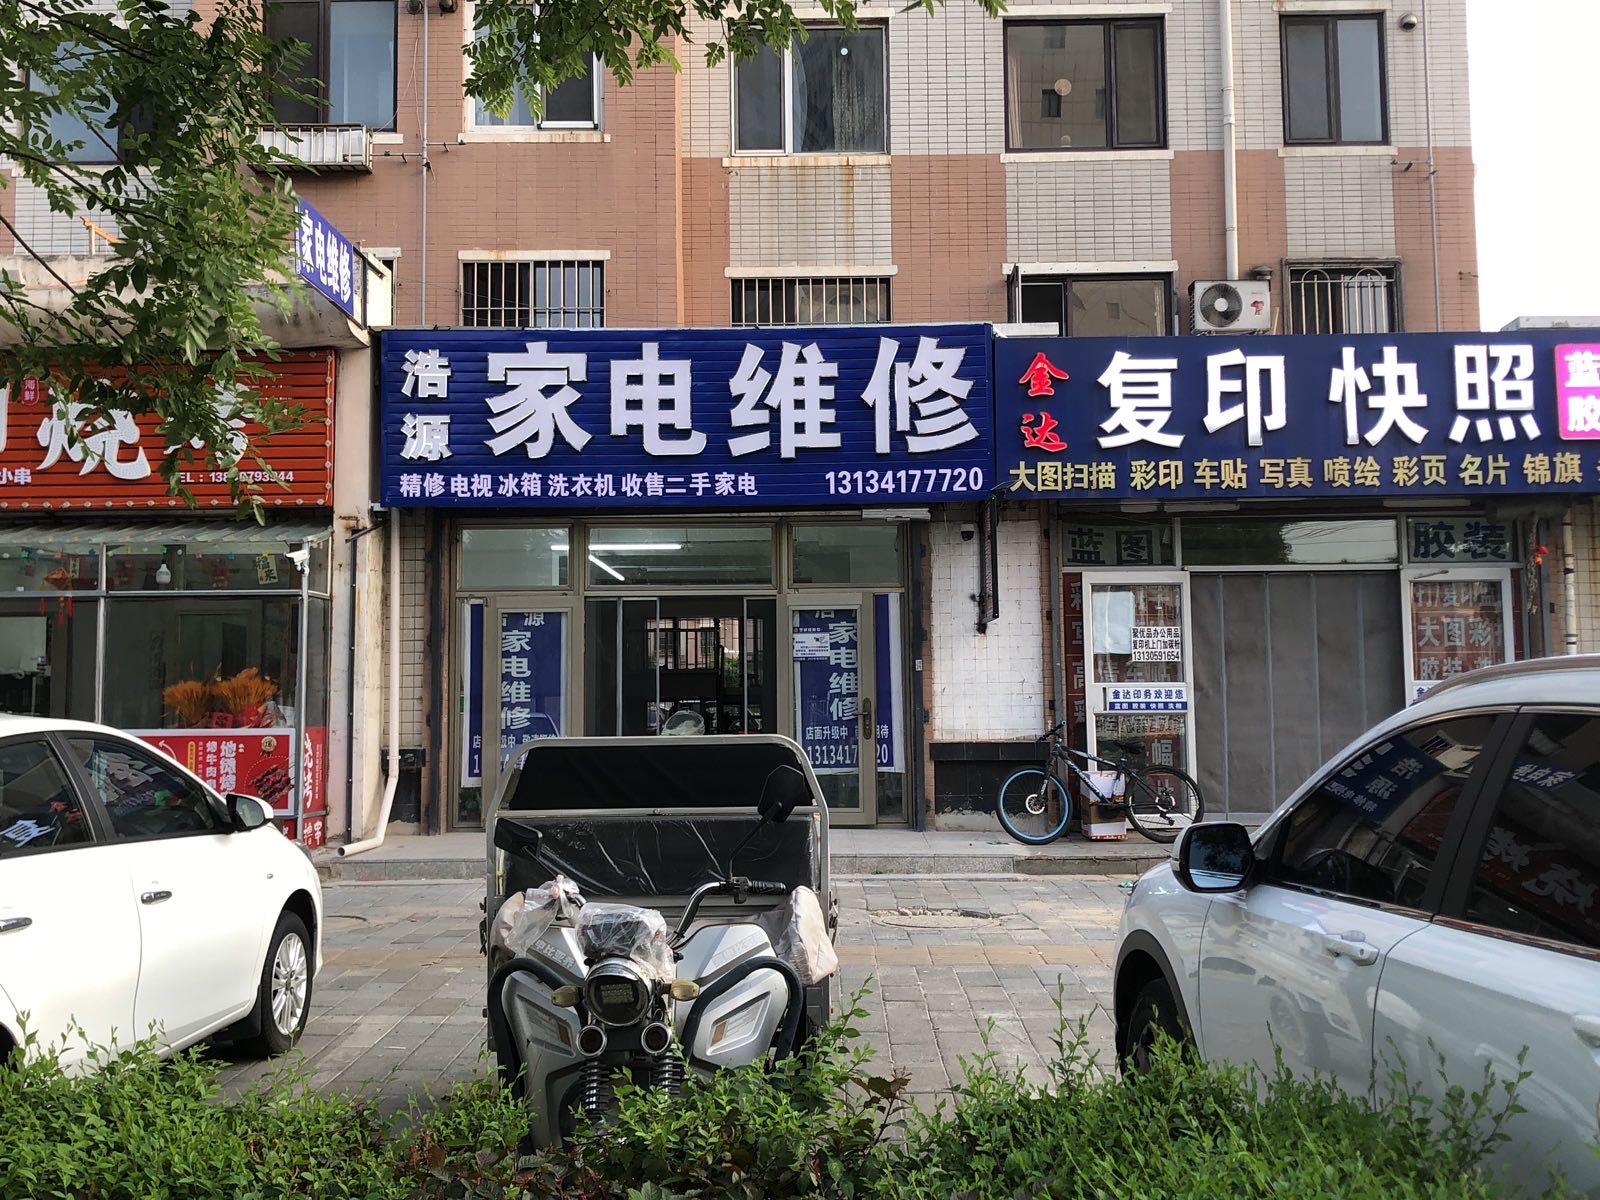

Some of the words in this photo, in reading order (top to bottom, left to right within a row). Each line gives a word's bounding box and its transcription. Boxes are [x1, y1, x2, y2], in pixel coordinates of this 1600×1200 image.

[400, 349, 452, 462] 浩源
[484, 337, 979, 460] 家电维修
[1019, 352, 1069, 453] 金达
[1097, 343, 1541, 450] 复印快照
[400, 474, 446, 498] 精修
[450, 475, 493, 498] 电视
[498, 474, 542, 497] 冰箱
[548, 473, 616, 497] 洗衣机
[621, 472, 759, 497] 收售二手家电
[825, 466, 983, 495] 13134177720
[1009, 459, 1116, 493] 大图扫描
[1130, 459, 1183, 491] 彩印
[1194, 458, 1248, 490] 车贴
[1259, 457, 1313, 489] 写真
[1323, 456, 1381, 488] 喷绘
[1393, 454, 1447, 486] 彩页
[1459, 453, 1510, 486] 名片
[1523, 452, 1583, 486] 锦旗
[1067, 527, 1153, 565] 蓝图
[1413, 521, 1506, 559] 胶装
[828, 621, 858, 721] 家电维修
[1132, 651, 1180, 661] 13130591654
[501, 630, 532, 730] 家电维修
[1112, 689, 1184, 700] 金达印务欢迎您
[805, 726, 849, 741] 店面升级中
[807, 743, 890, 765] 131341720
